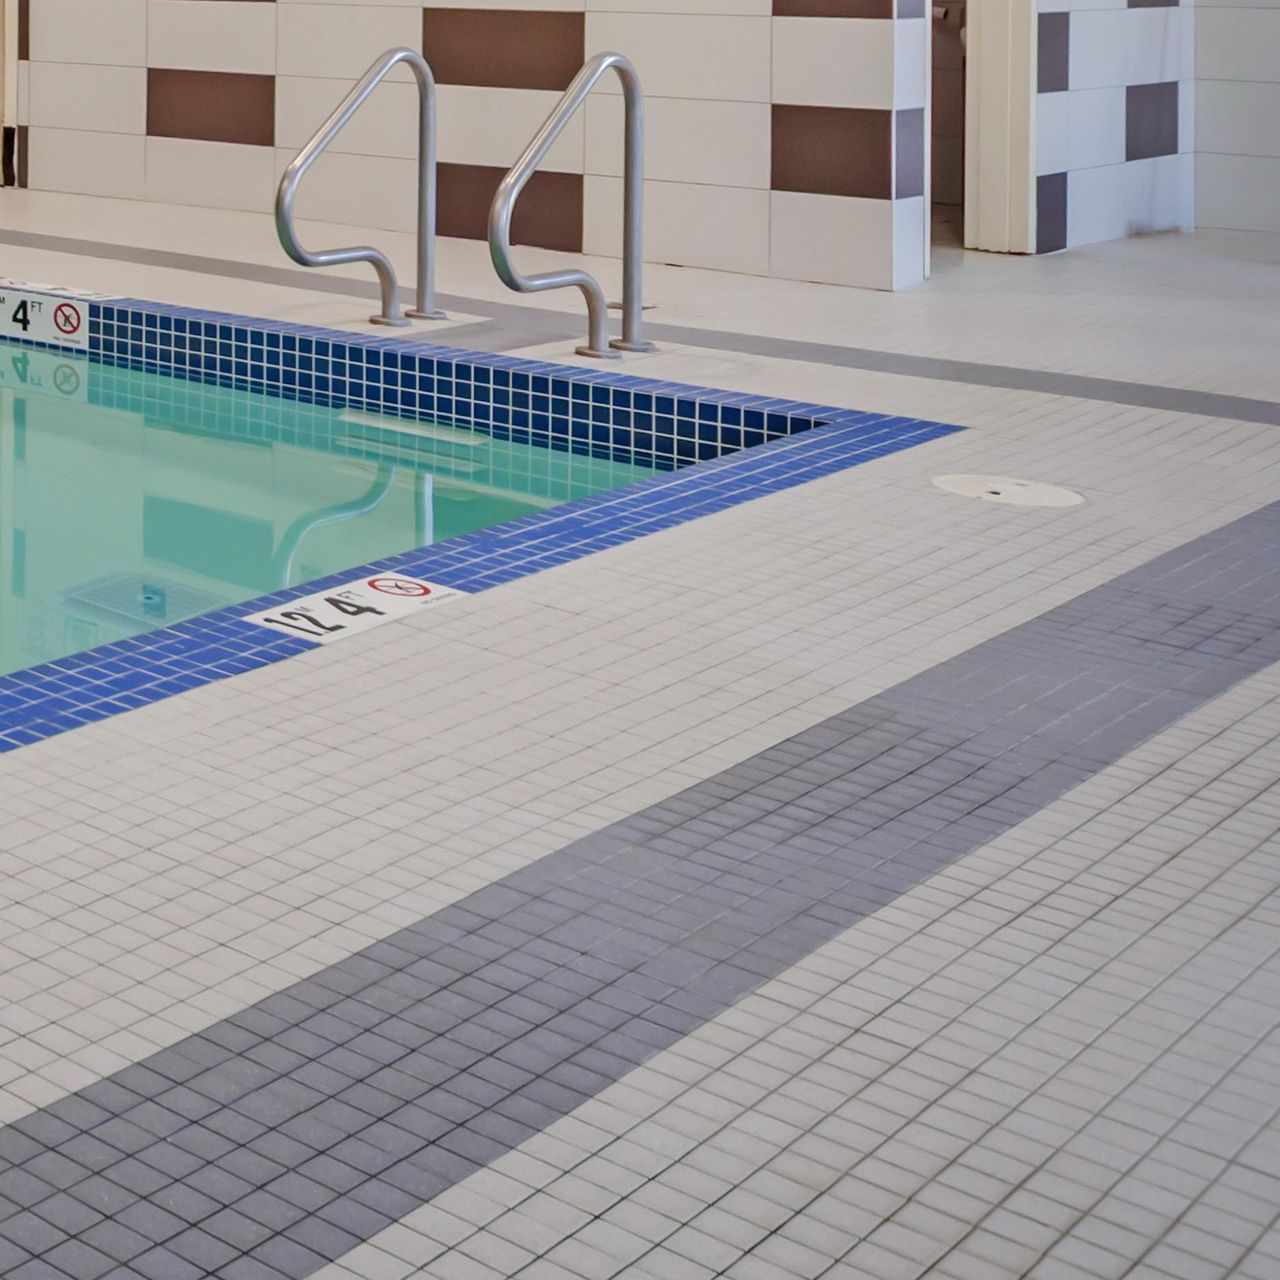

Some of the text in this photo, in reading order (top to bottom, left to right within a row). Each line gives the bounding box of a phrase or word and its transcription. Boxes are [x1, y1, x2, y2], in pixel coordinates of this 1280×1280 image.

[12, 300, 30, 331] 4
[31, 301, 43, 313] FT
[324, 596, 386, 616] 4
